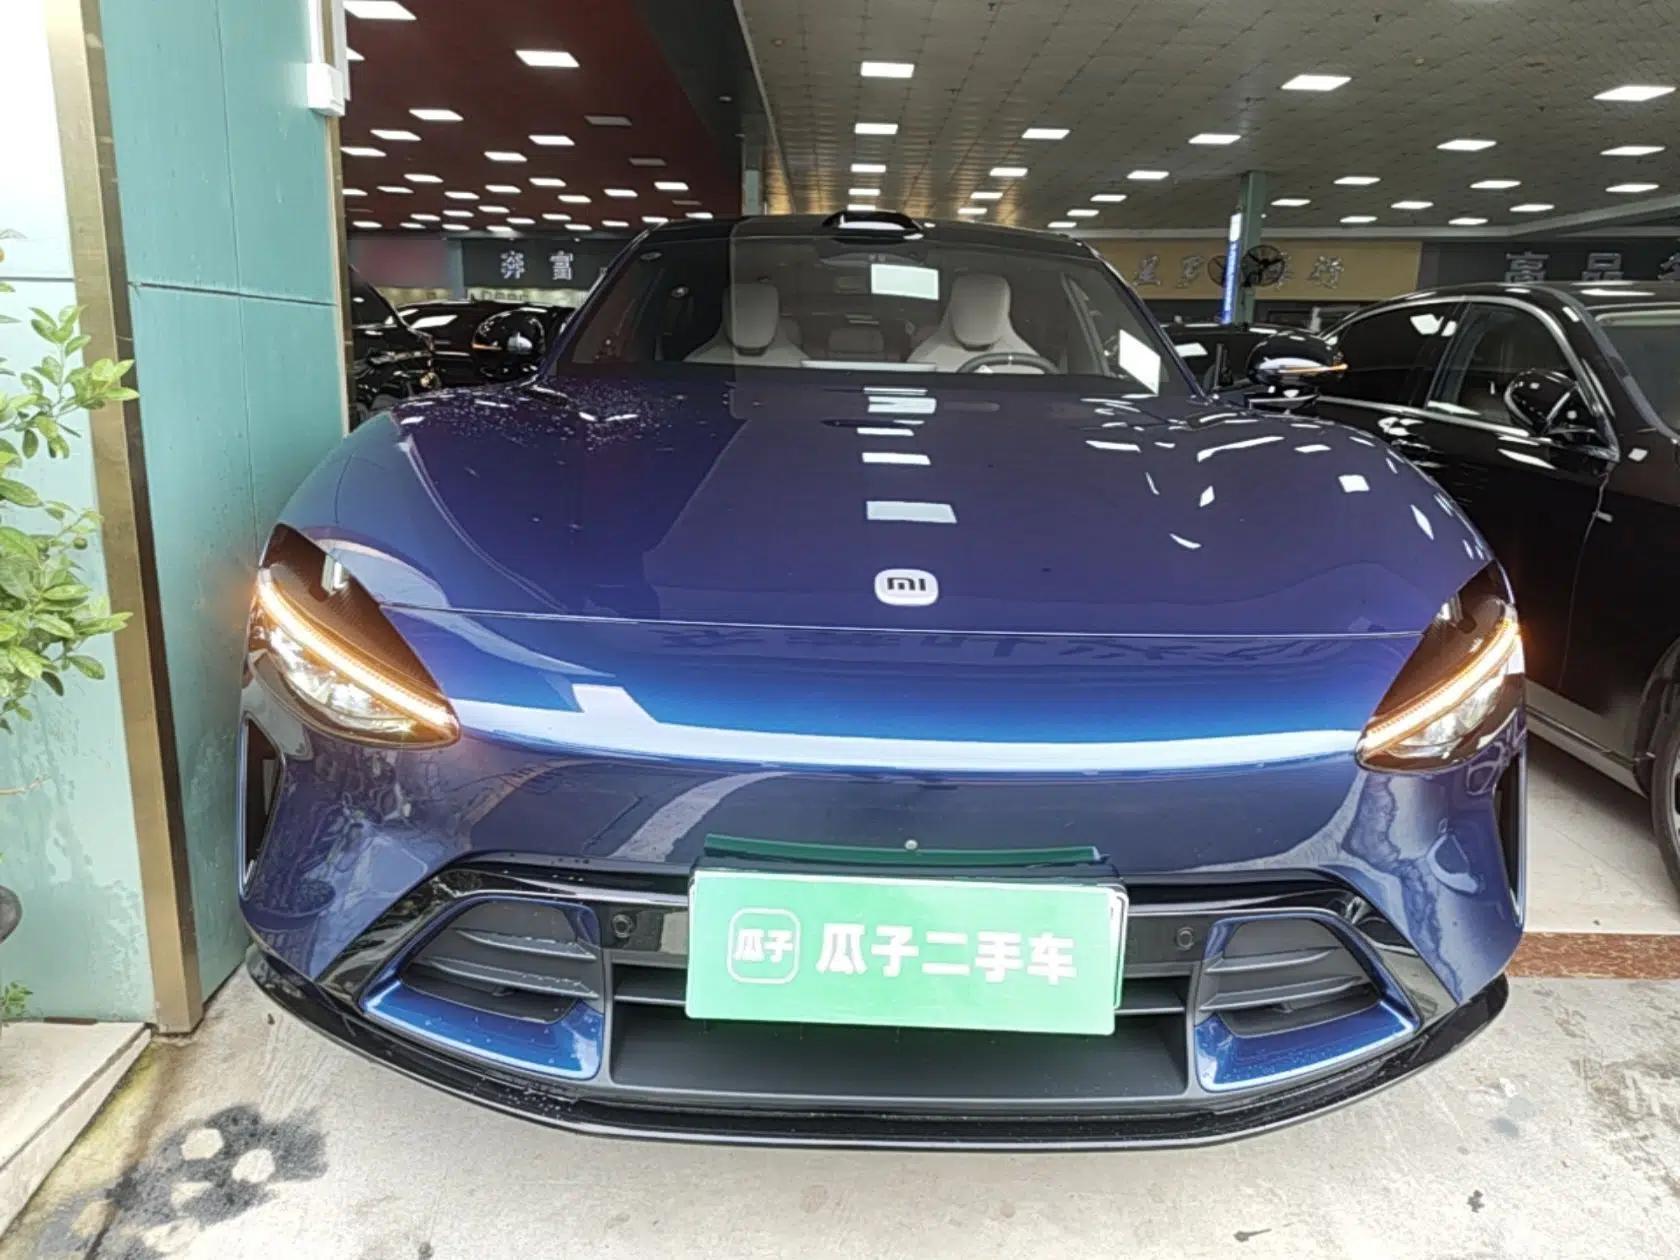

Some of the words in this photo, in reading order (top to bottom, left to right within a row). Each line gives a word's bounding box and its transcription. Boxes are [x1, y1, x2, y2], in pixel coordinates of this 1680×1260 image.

[733, 928, 796, 963] 瓜子
[816, 922, 1078, 984] 瓜子二手车
